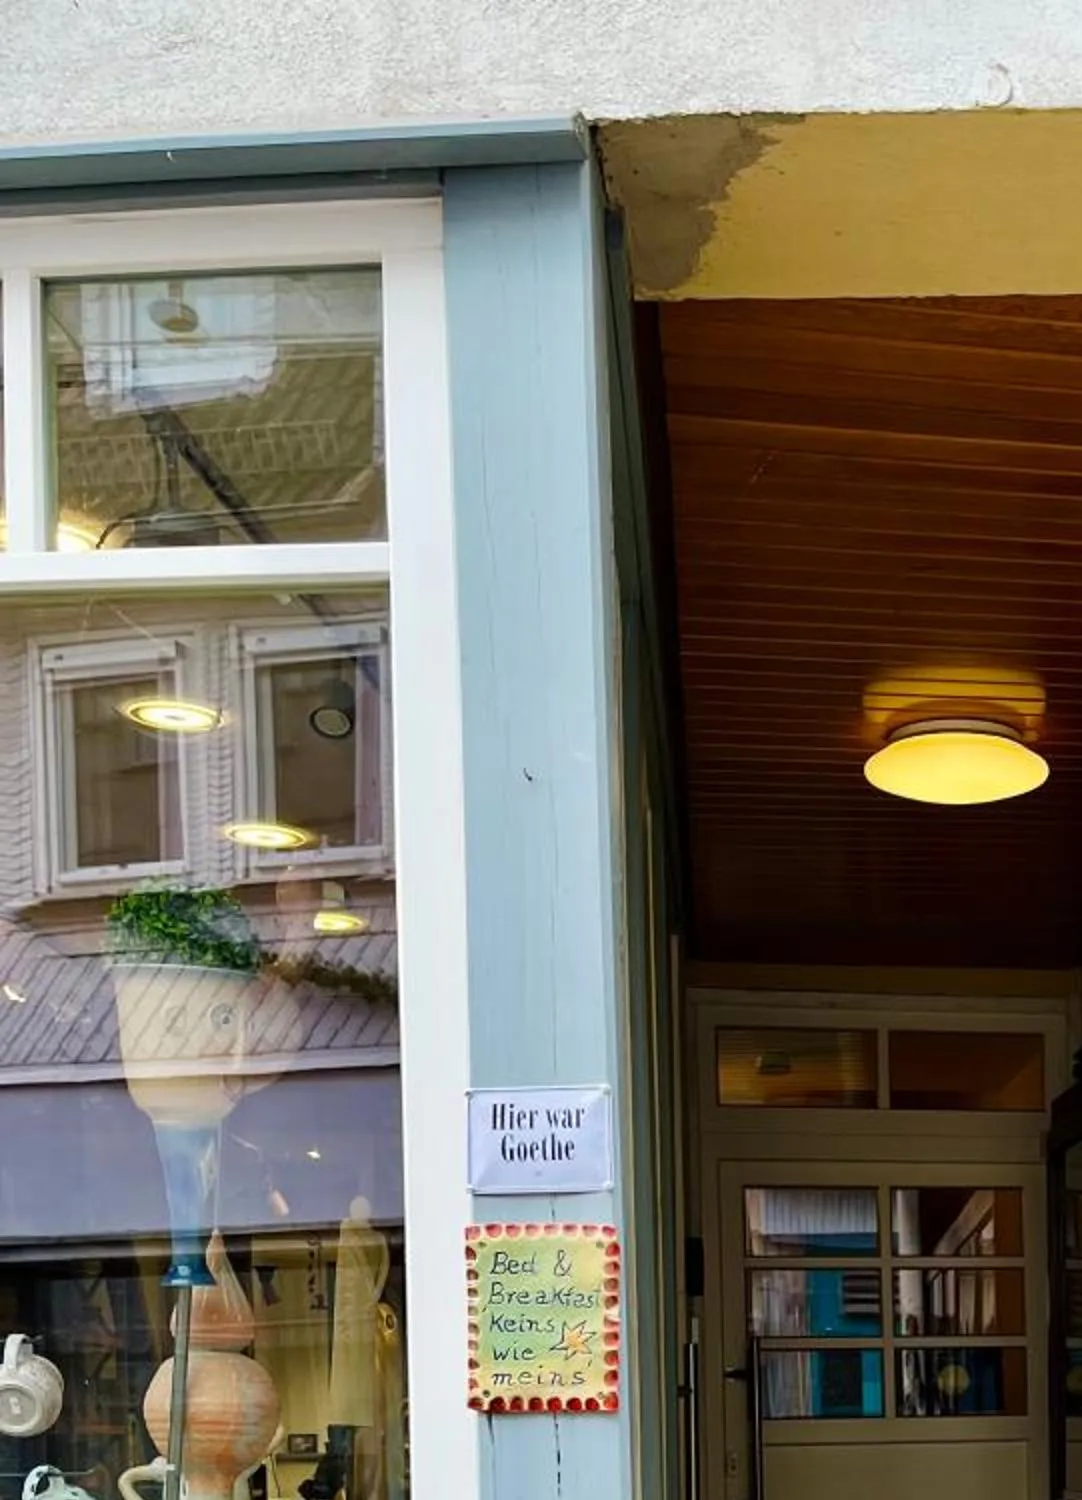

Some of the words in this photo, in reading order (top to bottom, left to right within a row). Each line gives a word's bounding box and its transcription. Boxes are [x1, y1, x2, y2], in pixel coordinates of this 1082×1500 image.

[491, 1103, 539, 1130] Hier
[546, 1108, 585, 1129] war
[501, 1132, 575, 1162] Goethe
[489, 1250, 537, 1275] Bed
[553, 1249, 573, 1277] &
[488, 1281, 601, 1308] Breakfast
[493, 1341, 536, 1361] wie
